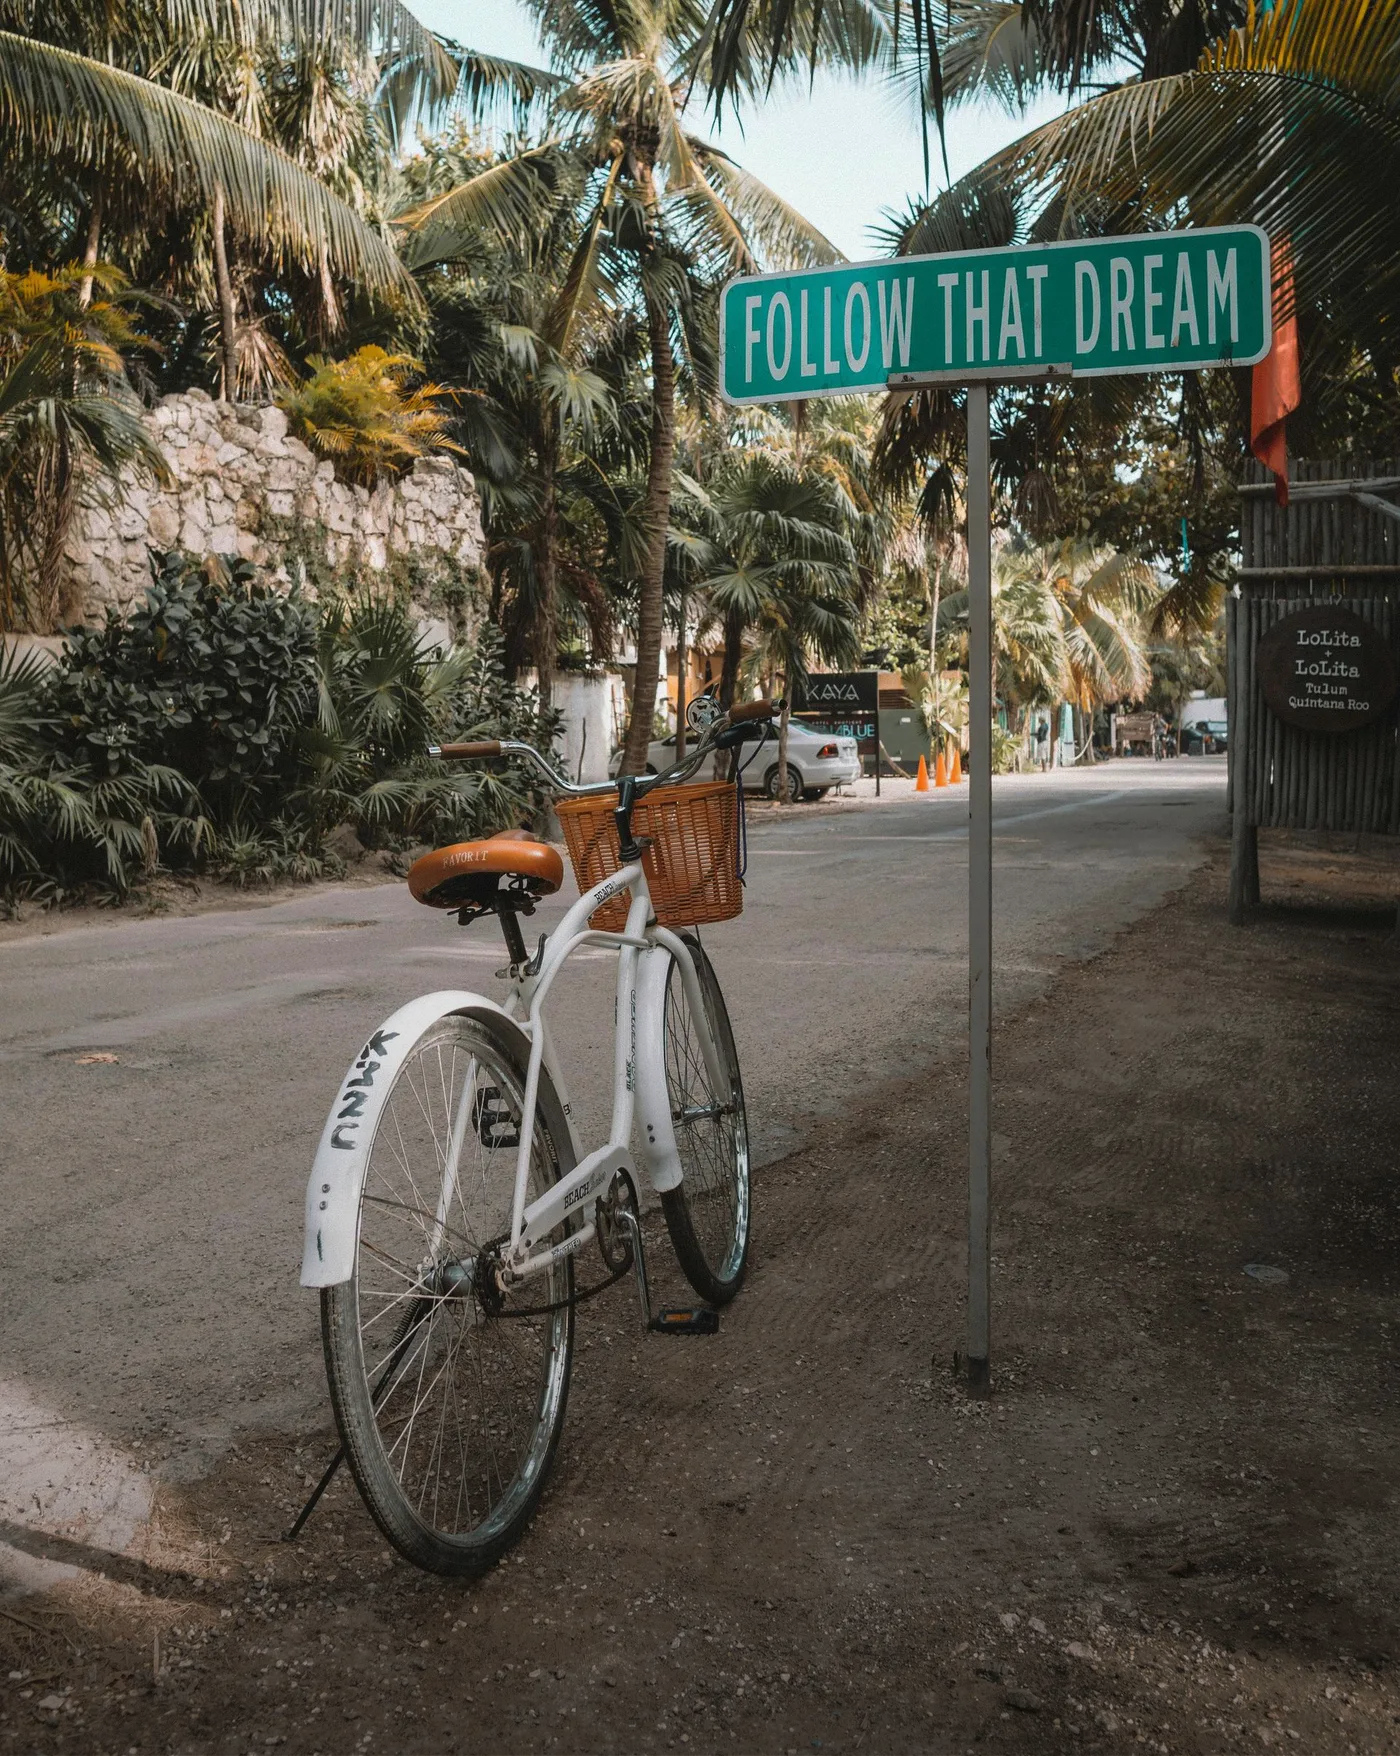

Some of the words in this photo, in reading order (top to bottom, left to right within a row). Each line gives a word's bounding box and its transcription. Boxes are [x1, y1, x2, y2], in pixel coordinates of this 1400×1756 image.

[744, 276, 915, 384] FOLLOW
[937, 264, 1049, 364] THAT
[1074, 247, 1238, 354] DREAM
[1296, 629, 1361, 647] LoLita
[1295, 659, 1360, 678] LoLita
[805, 683, 860, 701] KAYA
[1305, 682, 1348, 695] Tulum
[1288, 696, 1345, 710] Quintana
[1347, 699, 1370, 710] Roo
[442, 850, 489, 868] FAVORIT
[564, 1181, 589, 1210] BEACH
